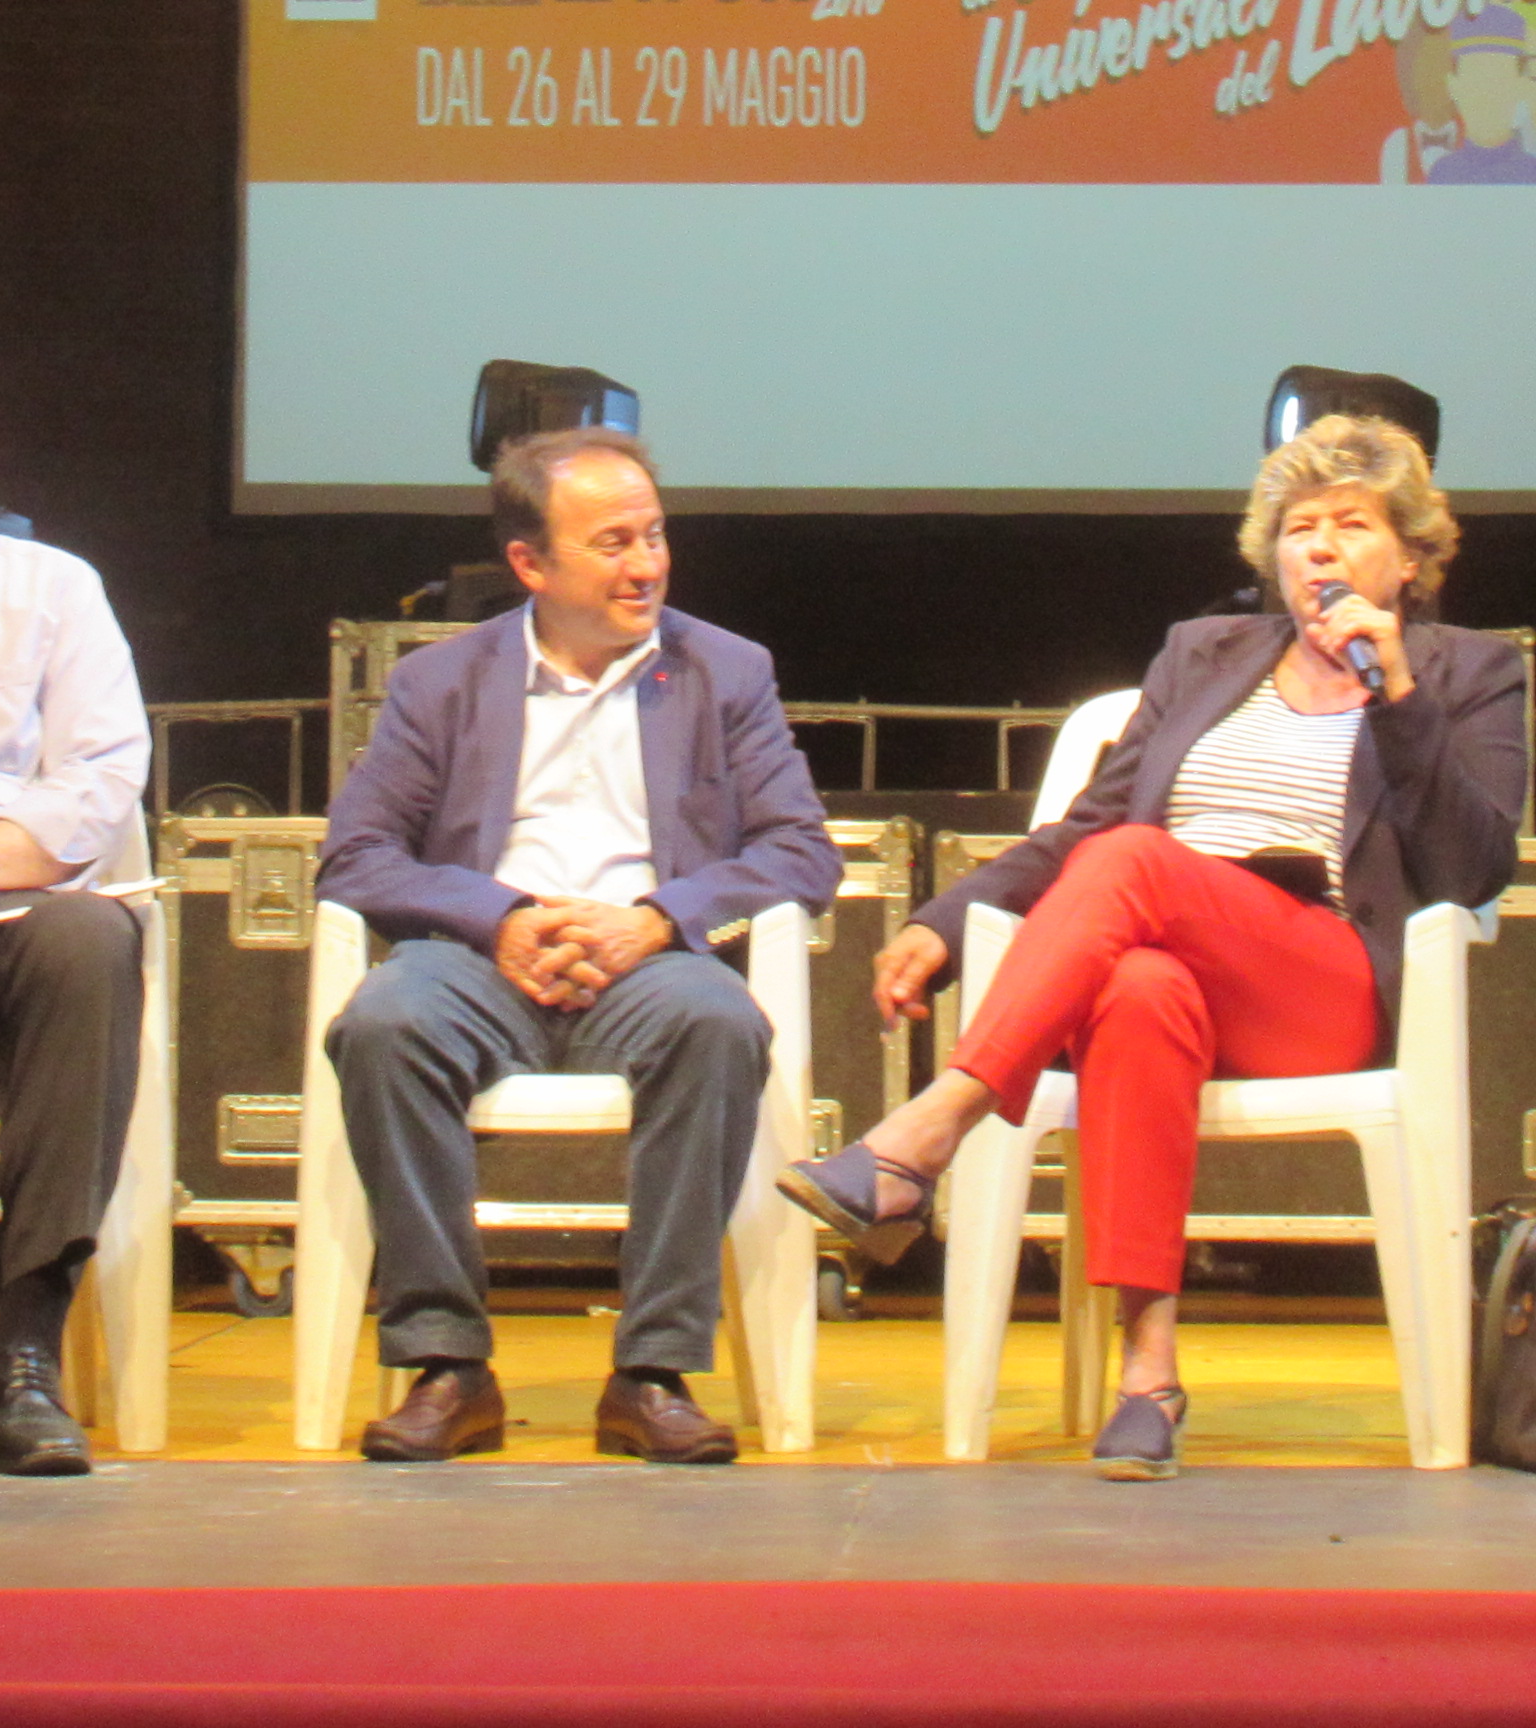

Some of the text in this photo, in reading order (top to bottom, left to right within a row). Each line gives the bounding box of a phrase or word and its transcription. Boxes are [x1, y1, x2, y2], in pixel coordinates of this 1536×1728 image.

[417, 47, 866, 128] DAL 26 AL 29 MAGGIO
[1215, 39, 1278, 117] del
